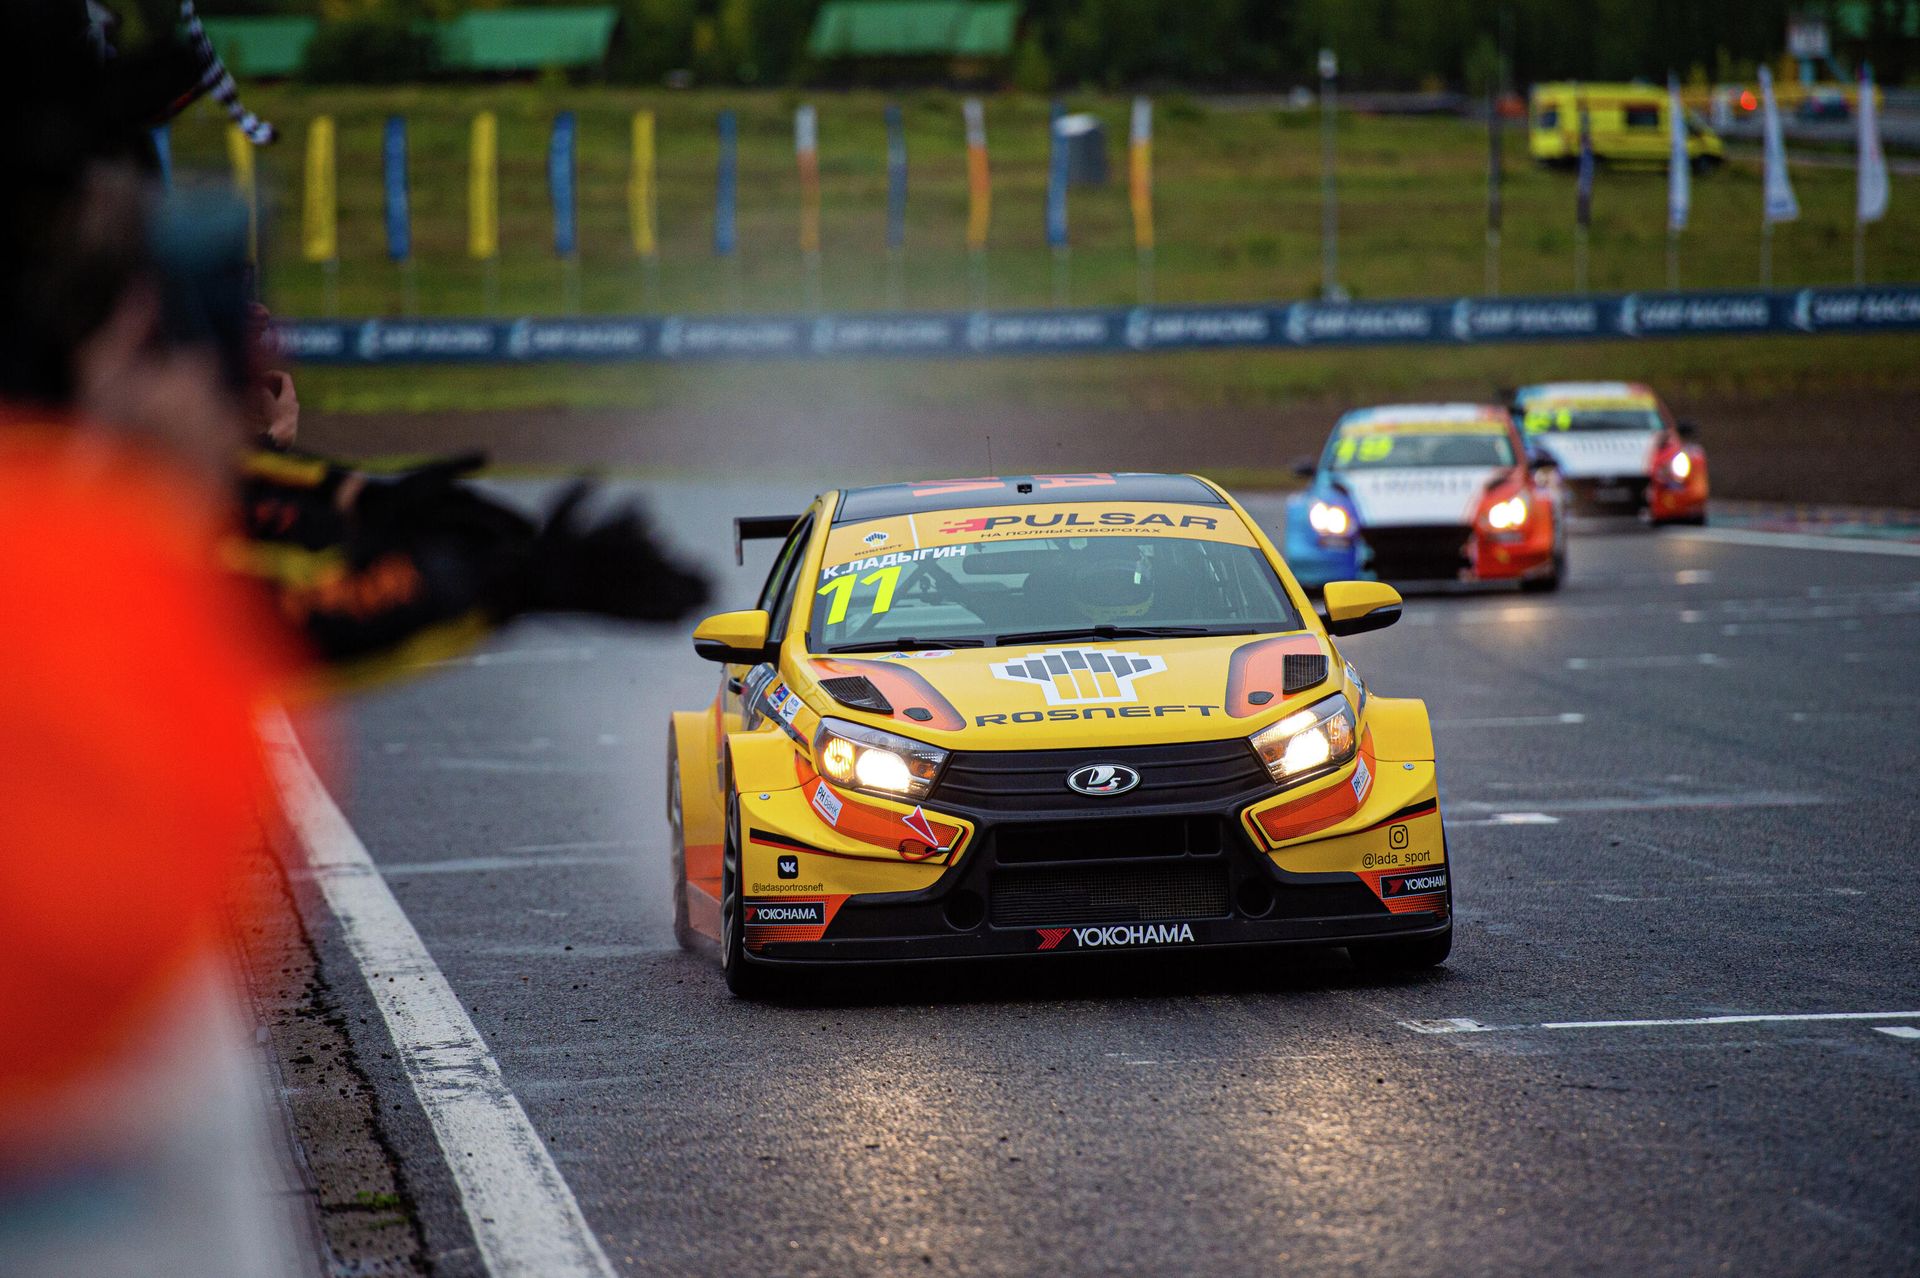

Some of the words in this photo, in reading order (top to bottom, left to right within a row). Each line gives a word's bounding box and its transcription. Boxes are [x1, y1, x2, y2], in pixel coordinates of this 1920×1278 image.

[984, 513, 1218, 530] PULSAR
[1006, 528, 1073, 536] ПОЛНЫХ
[823, 545, 967, 580] К.ЛАДЫГИН
[816, 565, 902, 625] 11
[975, 705, 1220, 727] ROSNEFT
[1362, 850, 1431, 868] @lada_sport
[752, 882, 824, 894] @ladasportrosneft
[757, 908, 818, 920] YOKOHAMA
[1073, 923, 1195, 947] YOKOHAMA
